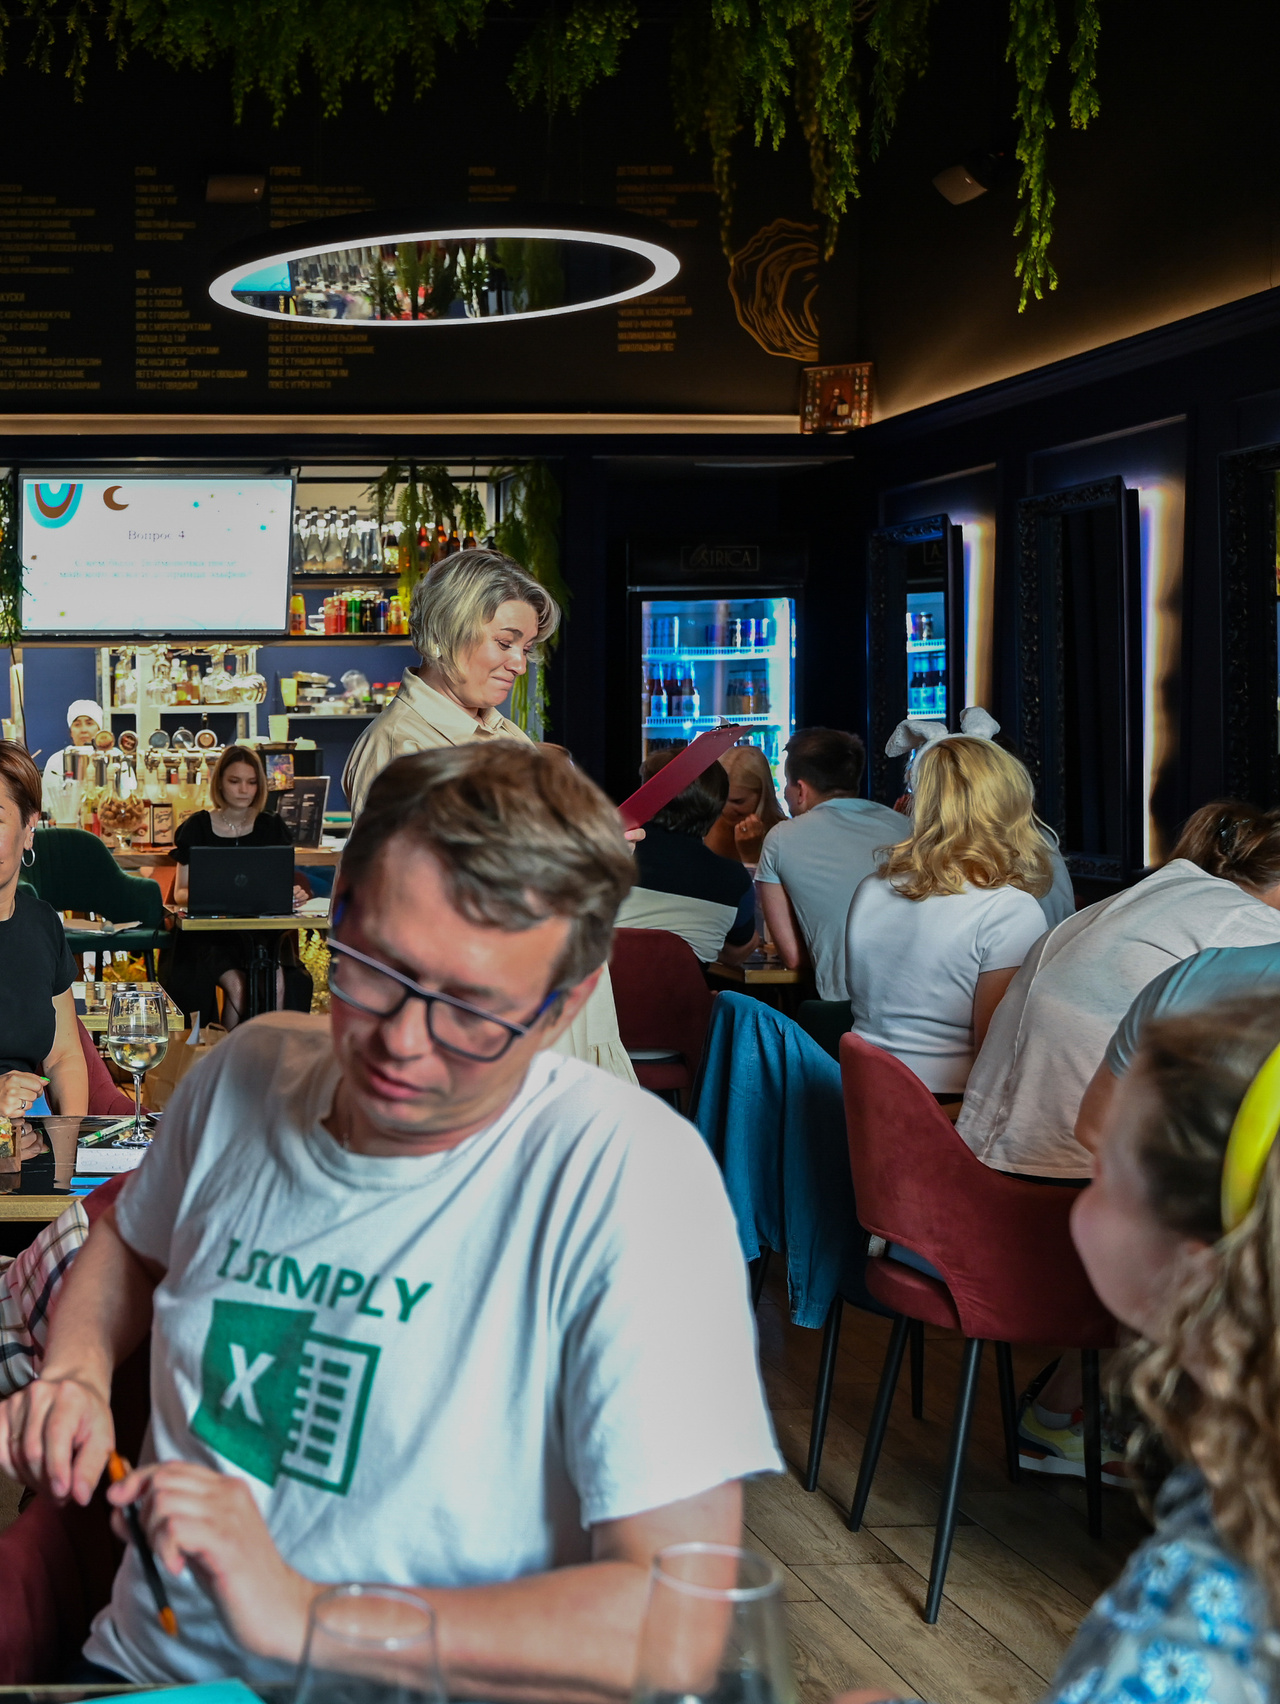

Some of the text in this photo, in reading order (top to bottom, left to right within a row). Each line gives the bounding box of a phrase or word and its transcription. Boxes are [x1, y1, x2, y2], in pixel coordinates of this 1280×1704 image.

[128, 530, 186, 542] Вопрос 4
[216, 1238, 433, 1323] I SIMPLY
